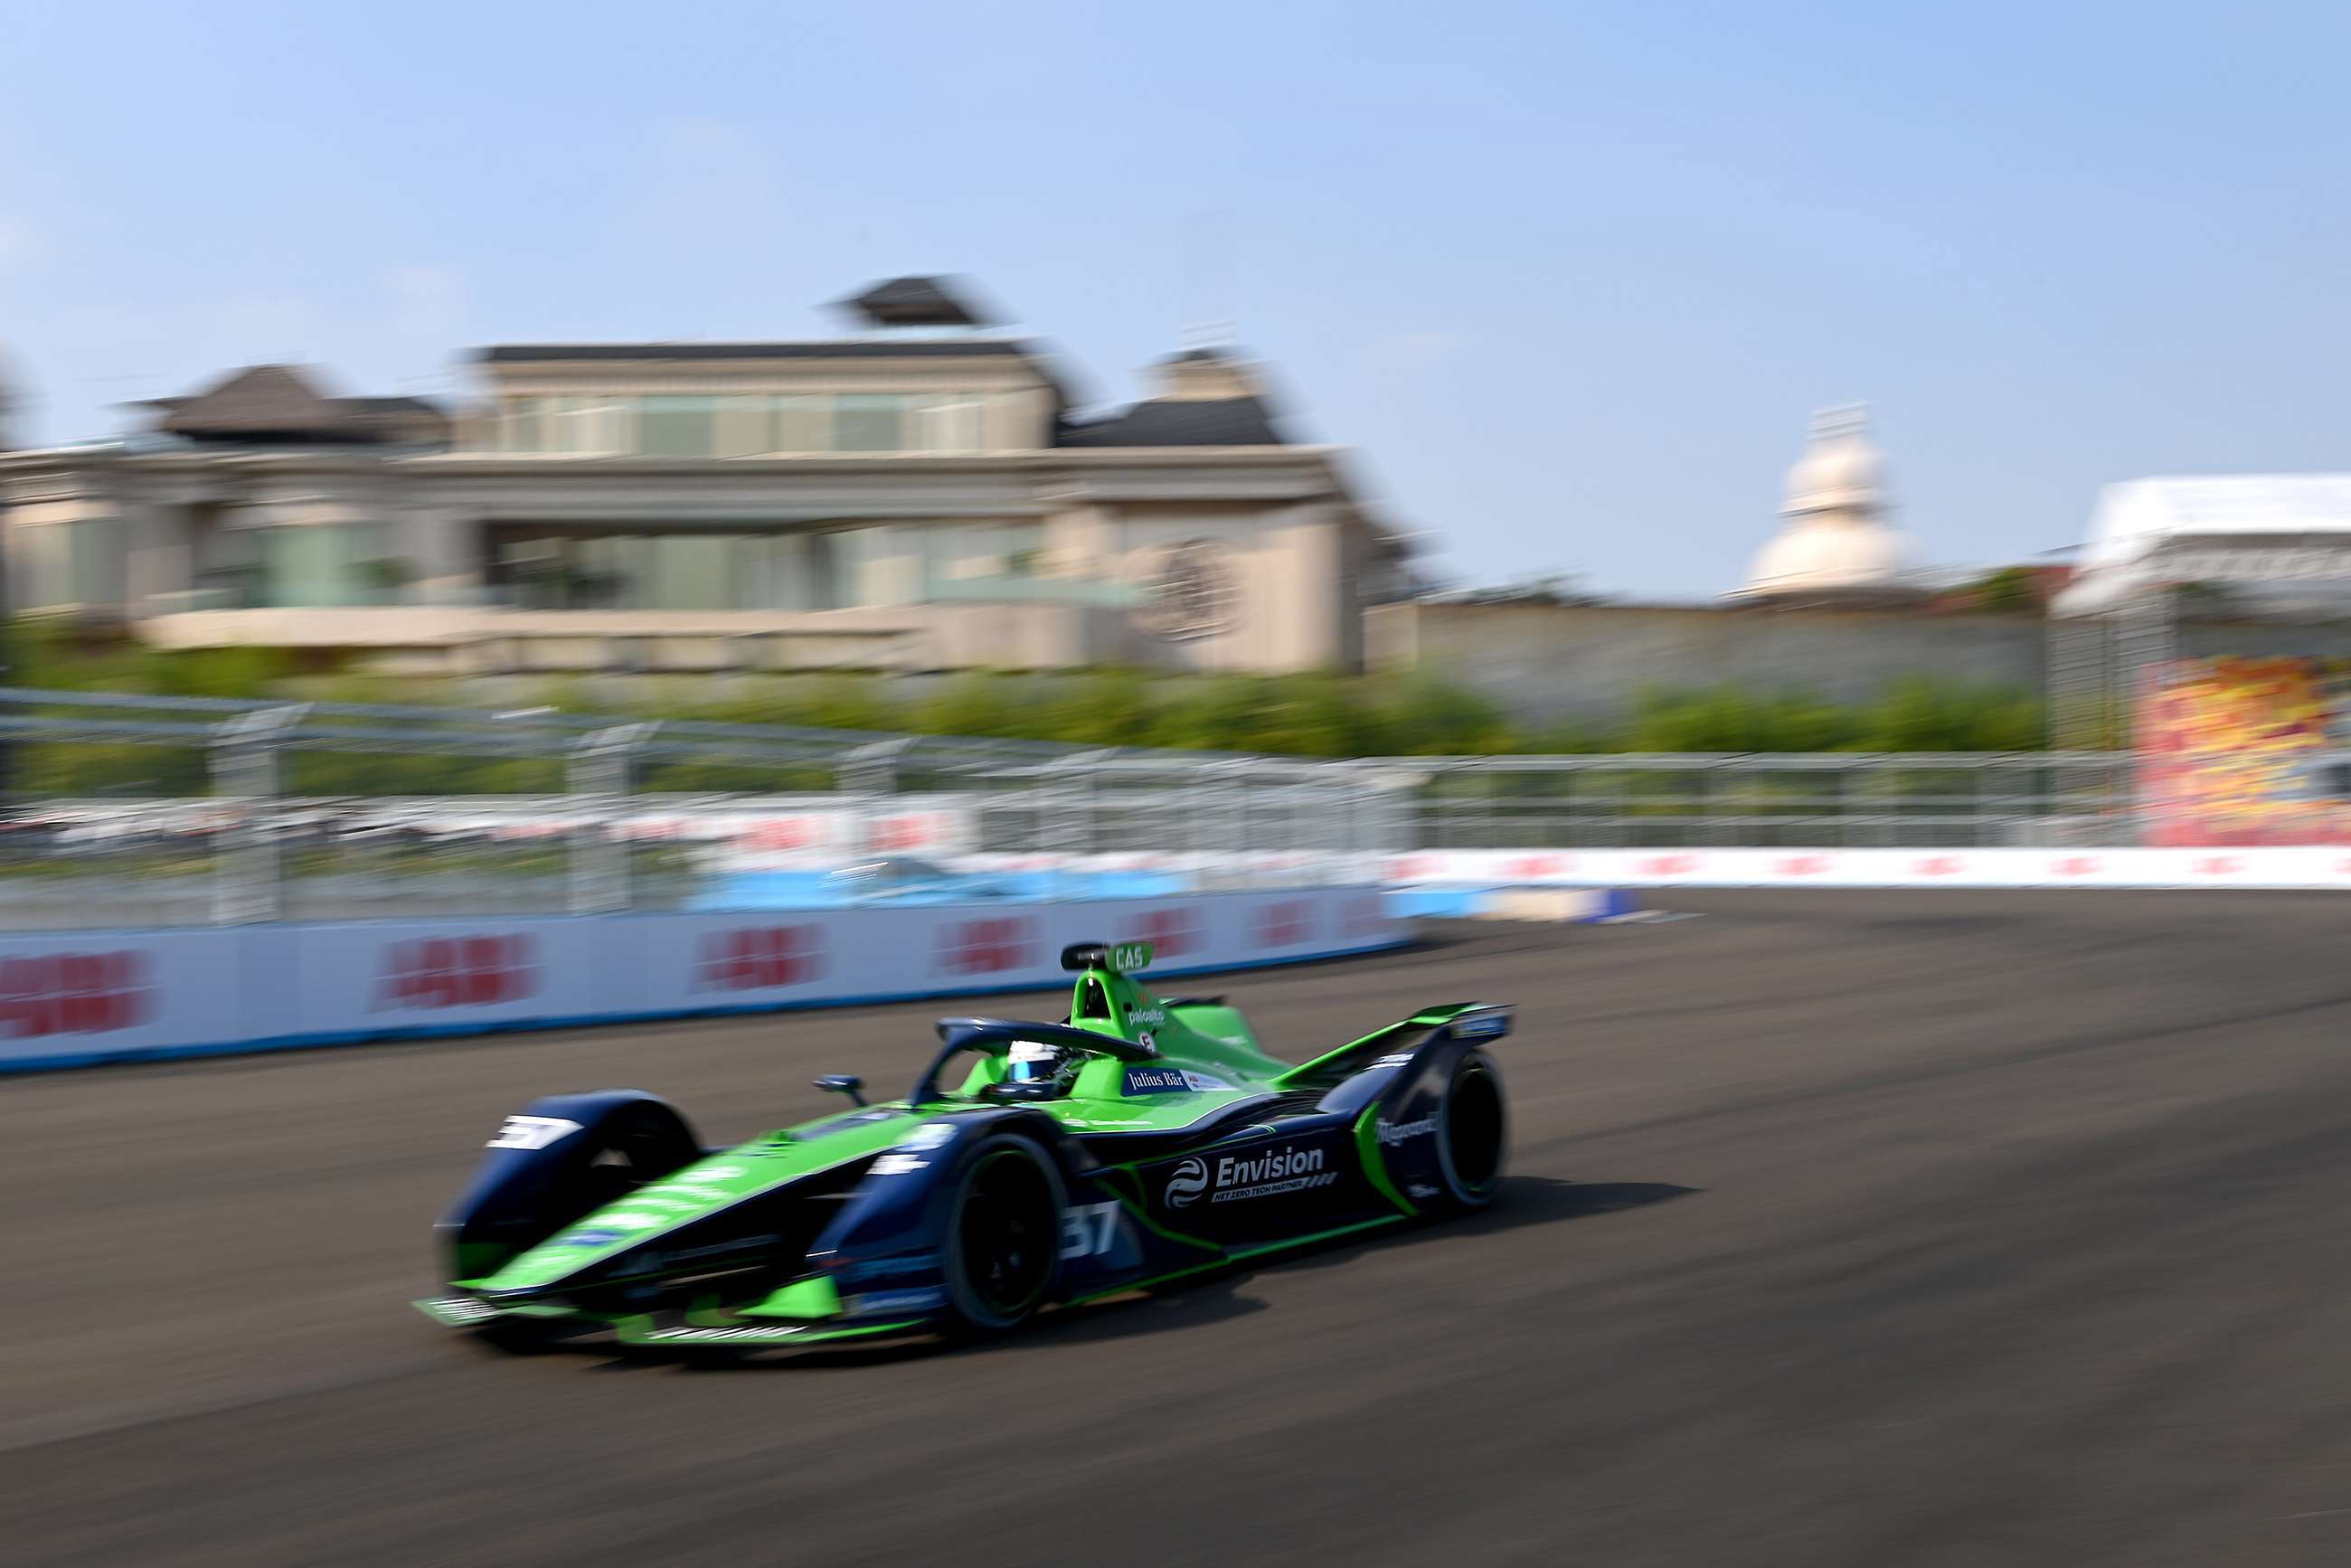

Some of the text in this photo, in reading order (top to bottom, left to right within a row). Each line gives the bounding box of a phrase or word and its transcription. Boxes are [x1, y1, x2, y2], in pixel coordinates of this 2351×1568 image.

[1116, 946, 1143, 970] CAS
[1128, 1072, 1164, 1091] Julius
[1163, 1072, 1184, 1086] Bär
[1216, 1147, 1324, 1187] Envision
[1060, 1199, 1121, 1259] 37
